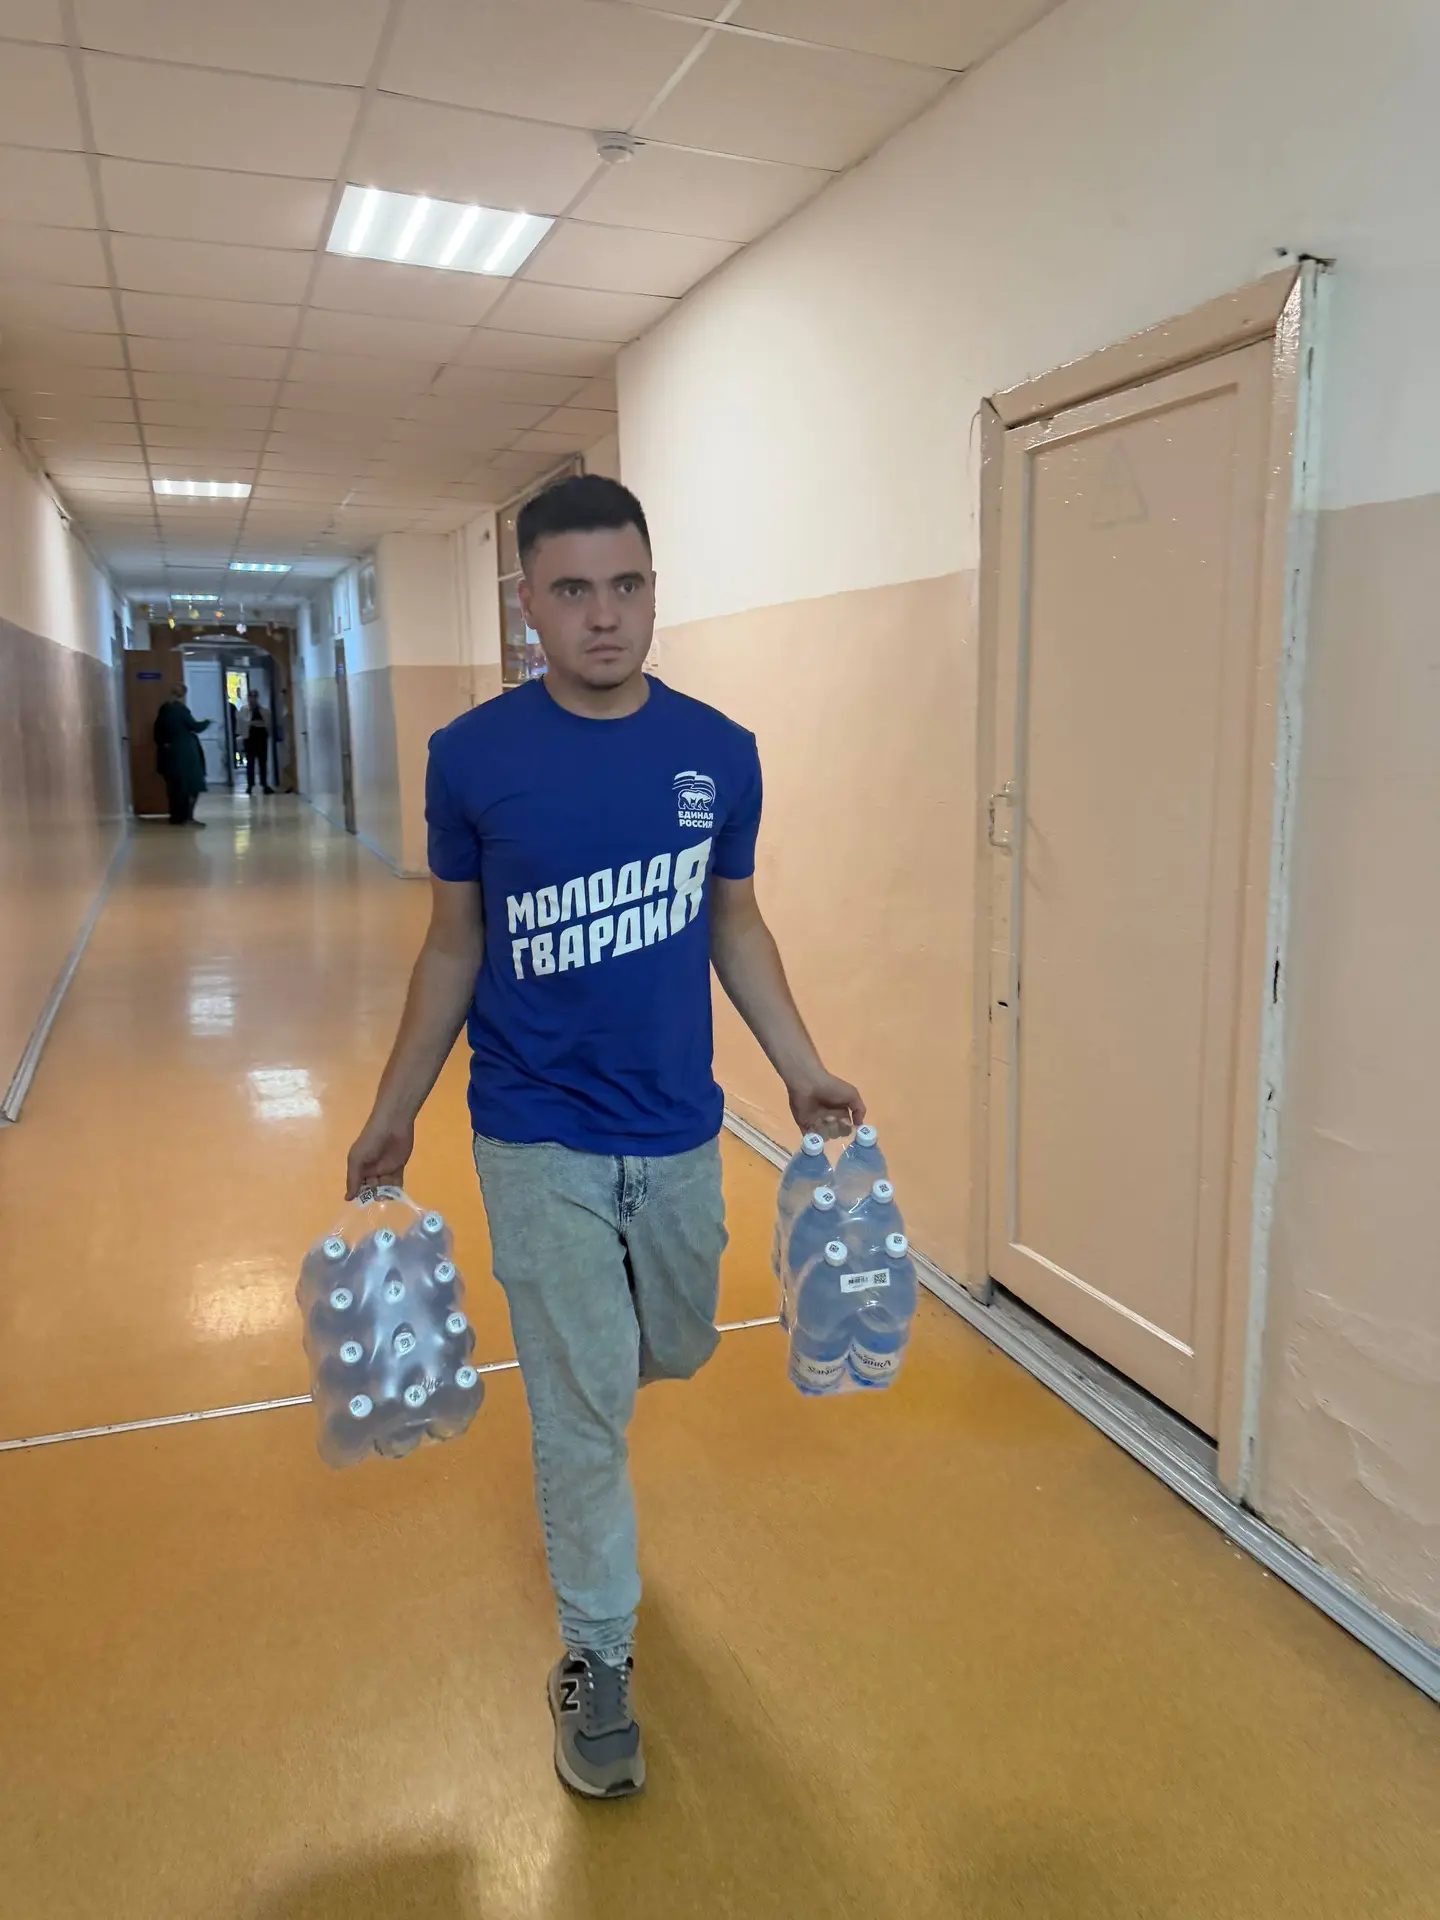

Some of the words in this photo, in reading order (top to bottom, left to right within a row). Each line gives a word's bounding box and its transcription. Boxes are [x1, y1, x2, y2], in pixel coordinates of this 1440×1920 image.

[678, 811, 714, 820] ЕДИНАЯ
[679, 819, 713, 829] РОССИЯ
[560, 1678, 581, 1714] N
